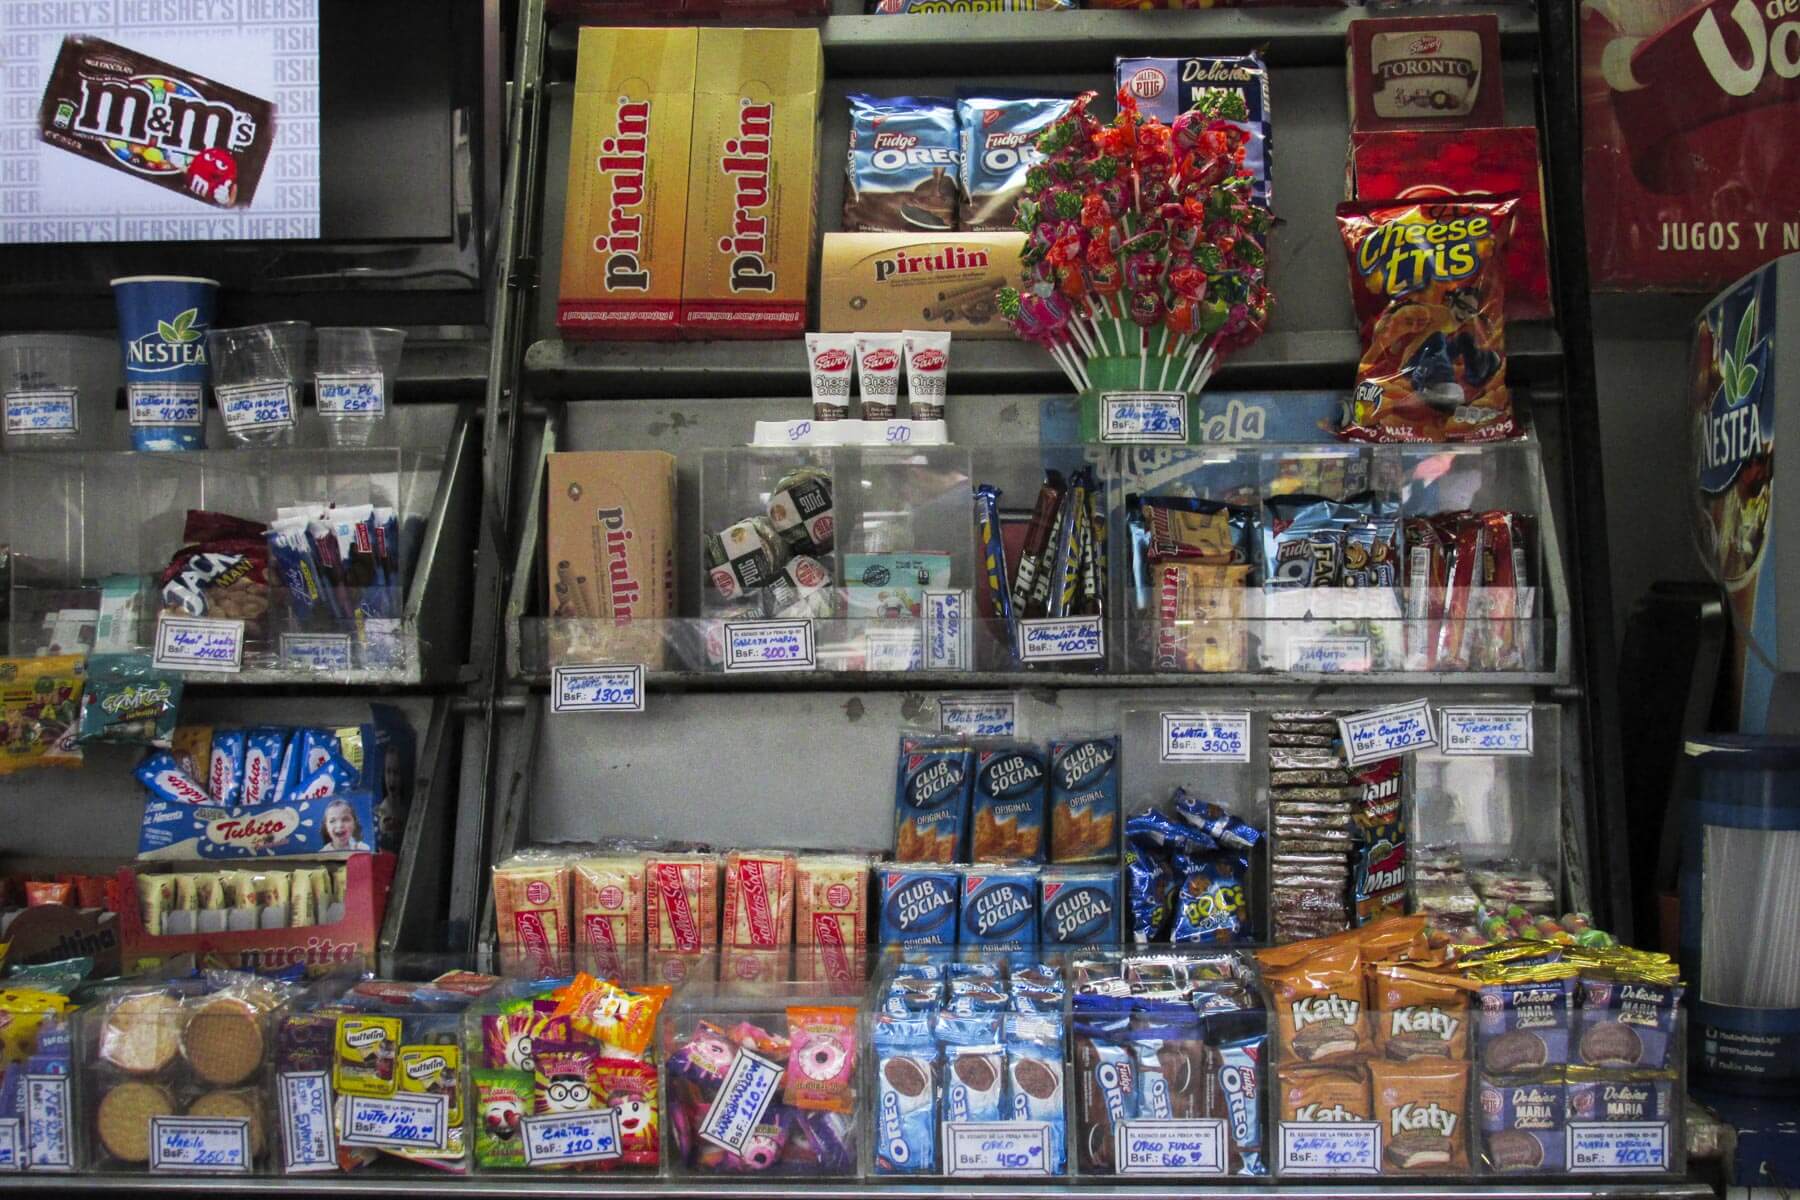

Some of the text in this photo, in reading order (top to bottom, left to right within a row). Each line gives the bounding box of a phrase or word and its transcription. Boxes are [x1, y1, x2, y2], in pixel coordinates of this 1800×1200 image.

[1380, 60, 1472, 79] TORONTO
[1136, 81, 1160, 95] PUIG
[874, 133, 917, 149] Fudge
[985, 133, 1029, 149] Fudge
[594, 98, 650, 292] pirulin
[719, 100, 776, 293] pirulin
[124, 218, 235, 240] HERSHEY'S
[1658, 223, 1741, 251] JUGOS
[1757, 222, 1777, 250] Y
[1360, 216, 1489, 274] Cheese
[873, 247, 988, 281] pirulin
[1386, 241, 1478, 297] tris
[128, 341, 207, 363] NESTEA
[788, 422, 811, 440] 500
[886, 426, 910, 441] 500
[1701, 404, 1762, 468] NESTEA
[599, 507, 637, 627] pirulin
[990, 755, 1024, 779] CLUB
[1063, 741, 1097, 772] CLUB
[1065, 751, 1113, 789] SOCIAL
[915, 763, 949, 787] CLUB
[915, 769, 964, 807] SOCIAL
[990, 764, 1043, 797] SOCIAL
[993, 802, 1032, 816] ORIGINAL
[1069, 789, 1105, 808] ORIGINAL
[216, 818, 287, 841] Tubito
[898, 882, 935, 908] CLUB
[899, 889, 954, 930] SOCIAL
[976, 886, 1014, 914] CLUB
[1055, 890, 1090, 921] CLUB
[977, 895, 1032, 936] SOCIAL
[1056, 899, 1112, 942] SOCIAL
[1291, 992, 1360, 1031] Katy
[1391, 1006, 1459, 1041] Katy
[1517, 1004, 1554, 1017] MARIA
[1621, 1002, 1657, 1016] MARIA
[1098, 1063, 1126, 1121] ORE
[1116, 1062, 1132, 1095] Fudge
[1240, 1065, 1256, 1099] Fudge
[1221, 1067, 1249, 1142] OREO
[1515, 1105, 1552, 1118] MARIA
[1606, 1102, 1643, 1115] MARIA
[883, 1090, 910, 1164] OREO
[1391, 1103, 1457, 1137] Katy
[960, 1154, 988, 1165] BsF.:
[1130, 1152, 1159, 1164] BsF.:
[1290, 1151, 1318, 1162] BsF.:
[1577, 1153, 1605, 1164] BsF.:
